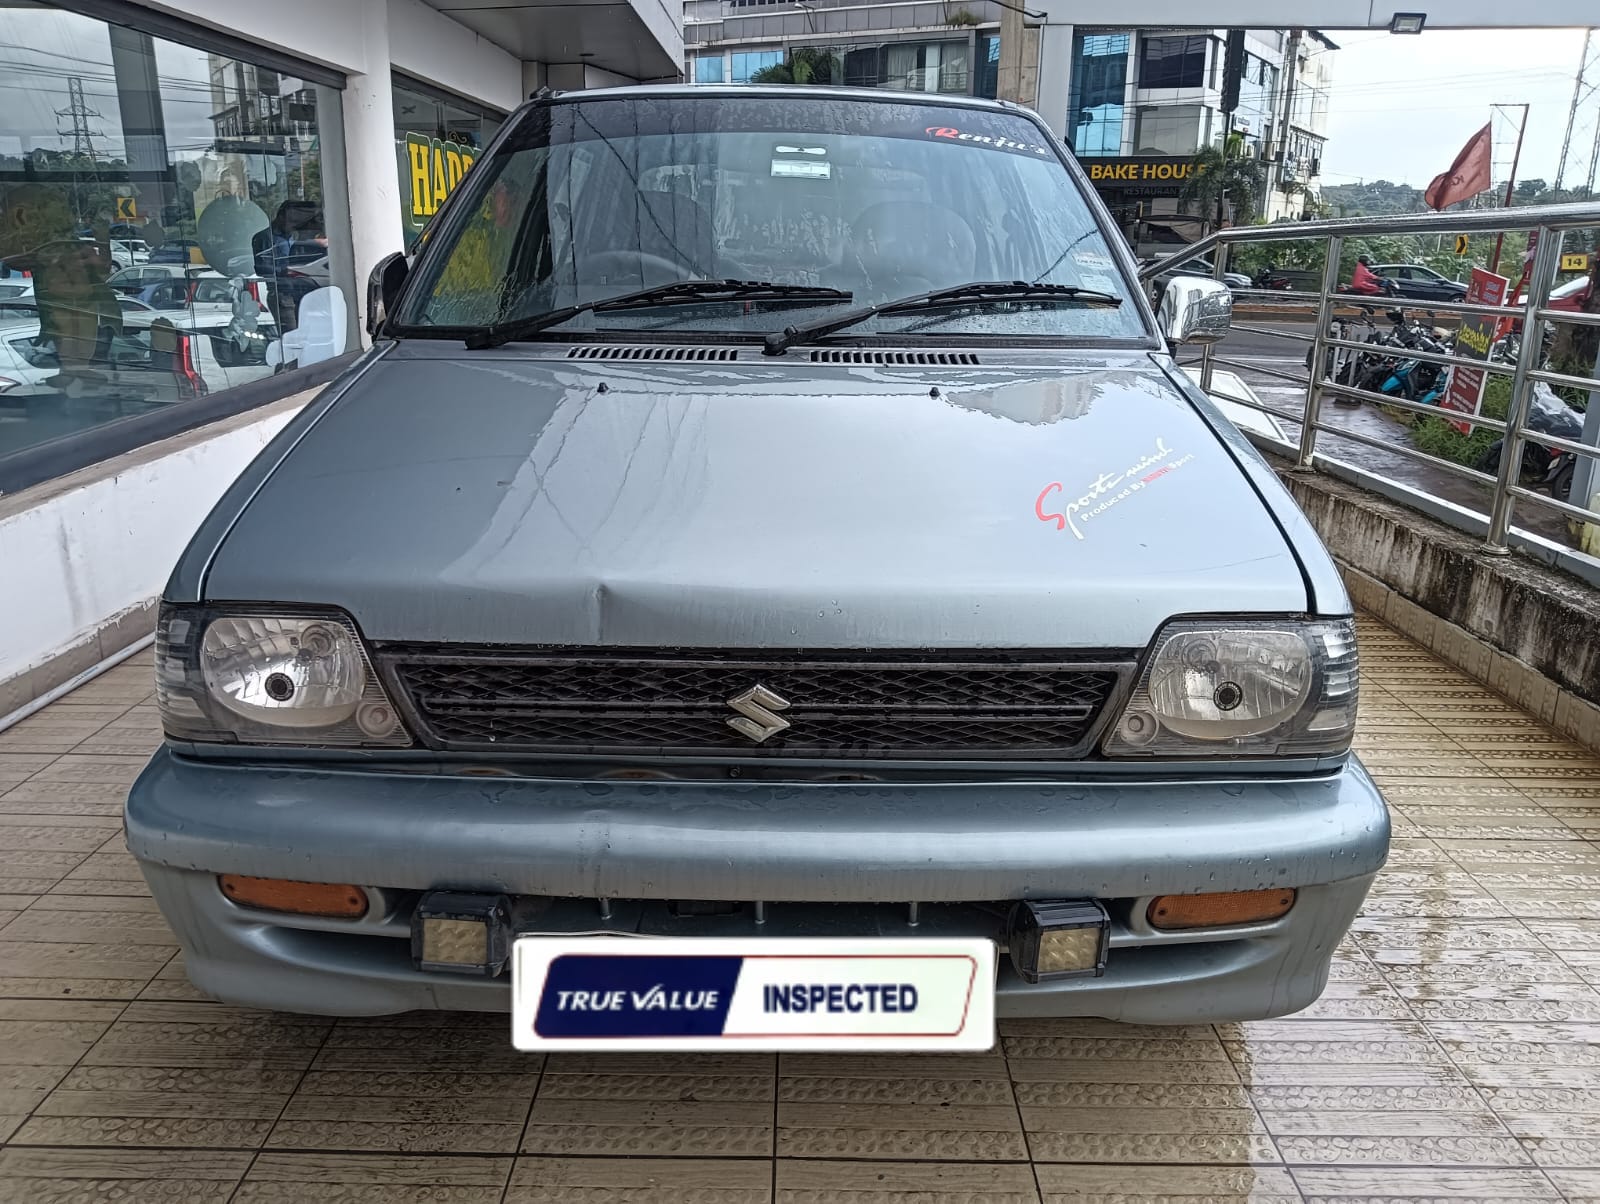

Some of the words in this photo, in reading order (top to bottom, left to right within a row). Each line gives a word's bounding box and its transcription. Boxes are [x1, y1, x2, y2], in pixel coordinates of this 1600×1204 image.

[1090, 164, 1139, 180] BAKE
[1566, 257, 1583, 267] 14
[1080, 488, 1131, 522] Produced
